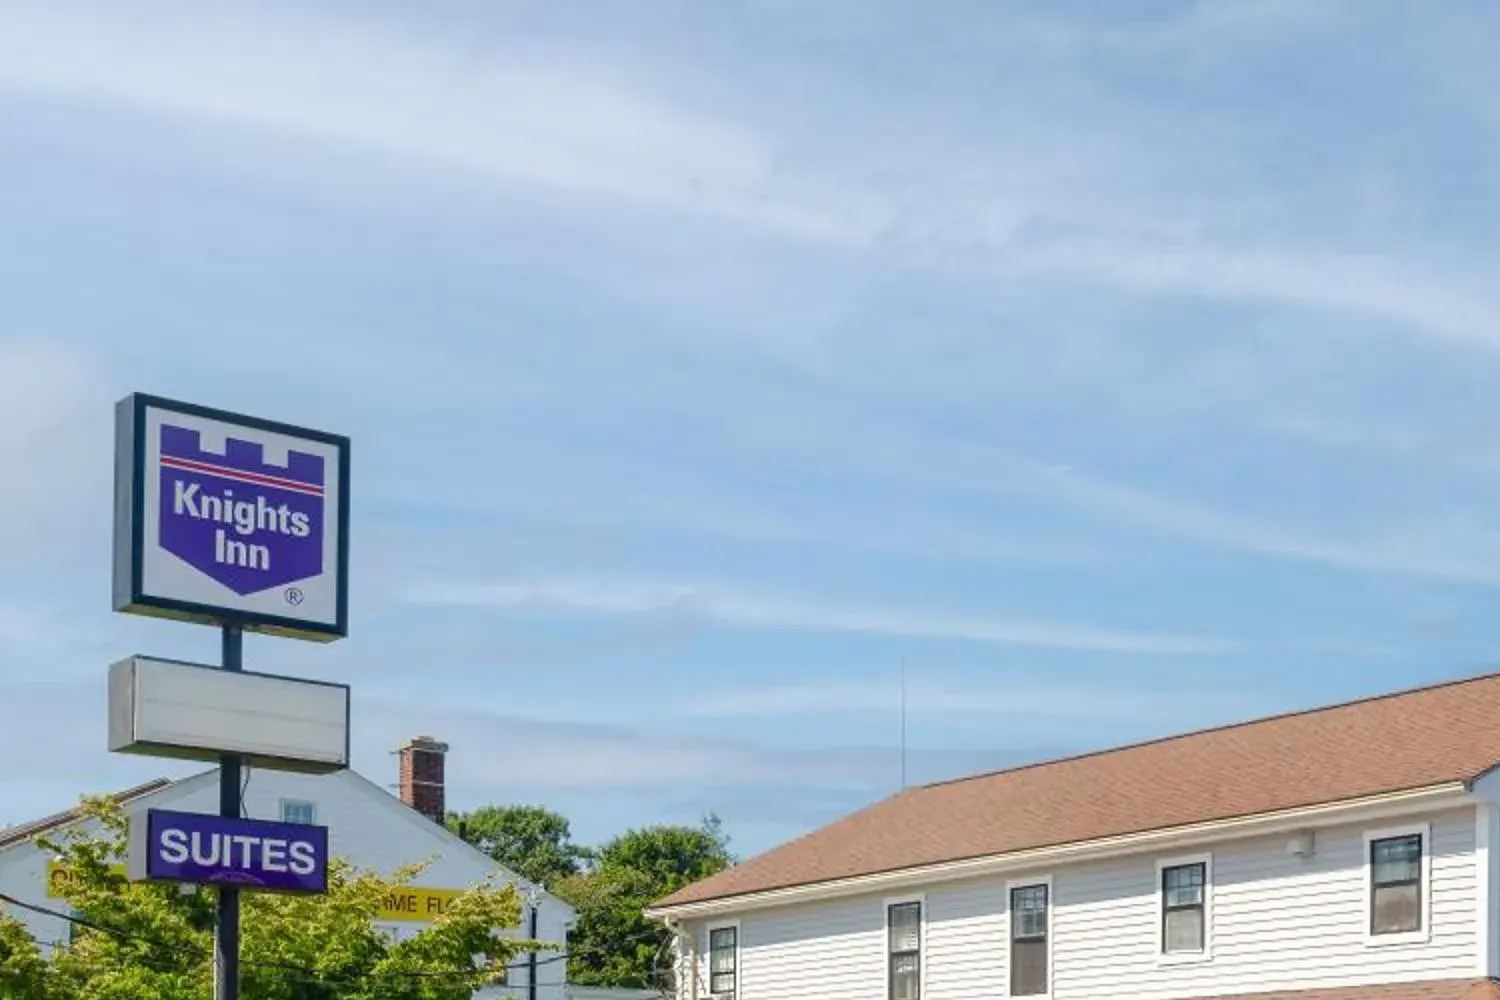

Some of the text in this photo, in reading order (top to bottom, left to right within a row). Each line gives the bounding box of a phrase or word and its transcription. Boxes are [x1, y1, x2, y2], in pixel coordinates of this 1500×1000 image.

[173, 480, 310, 537] Knights
[215, 530, 270, 571] Inn
[159, 828, 316, 875] SUITES
